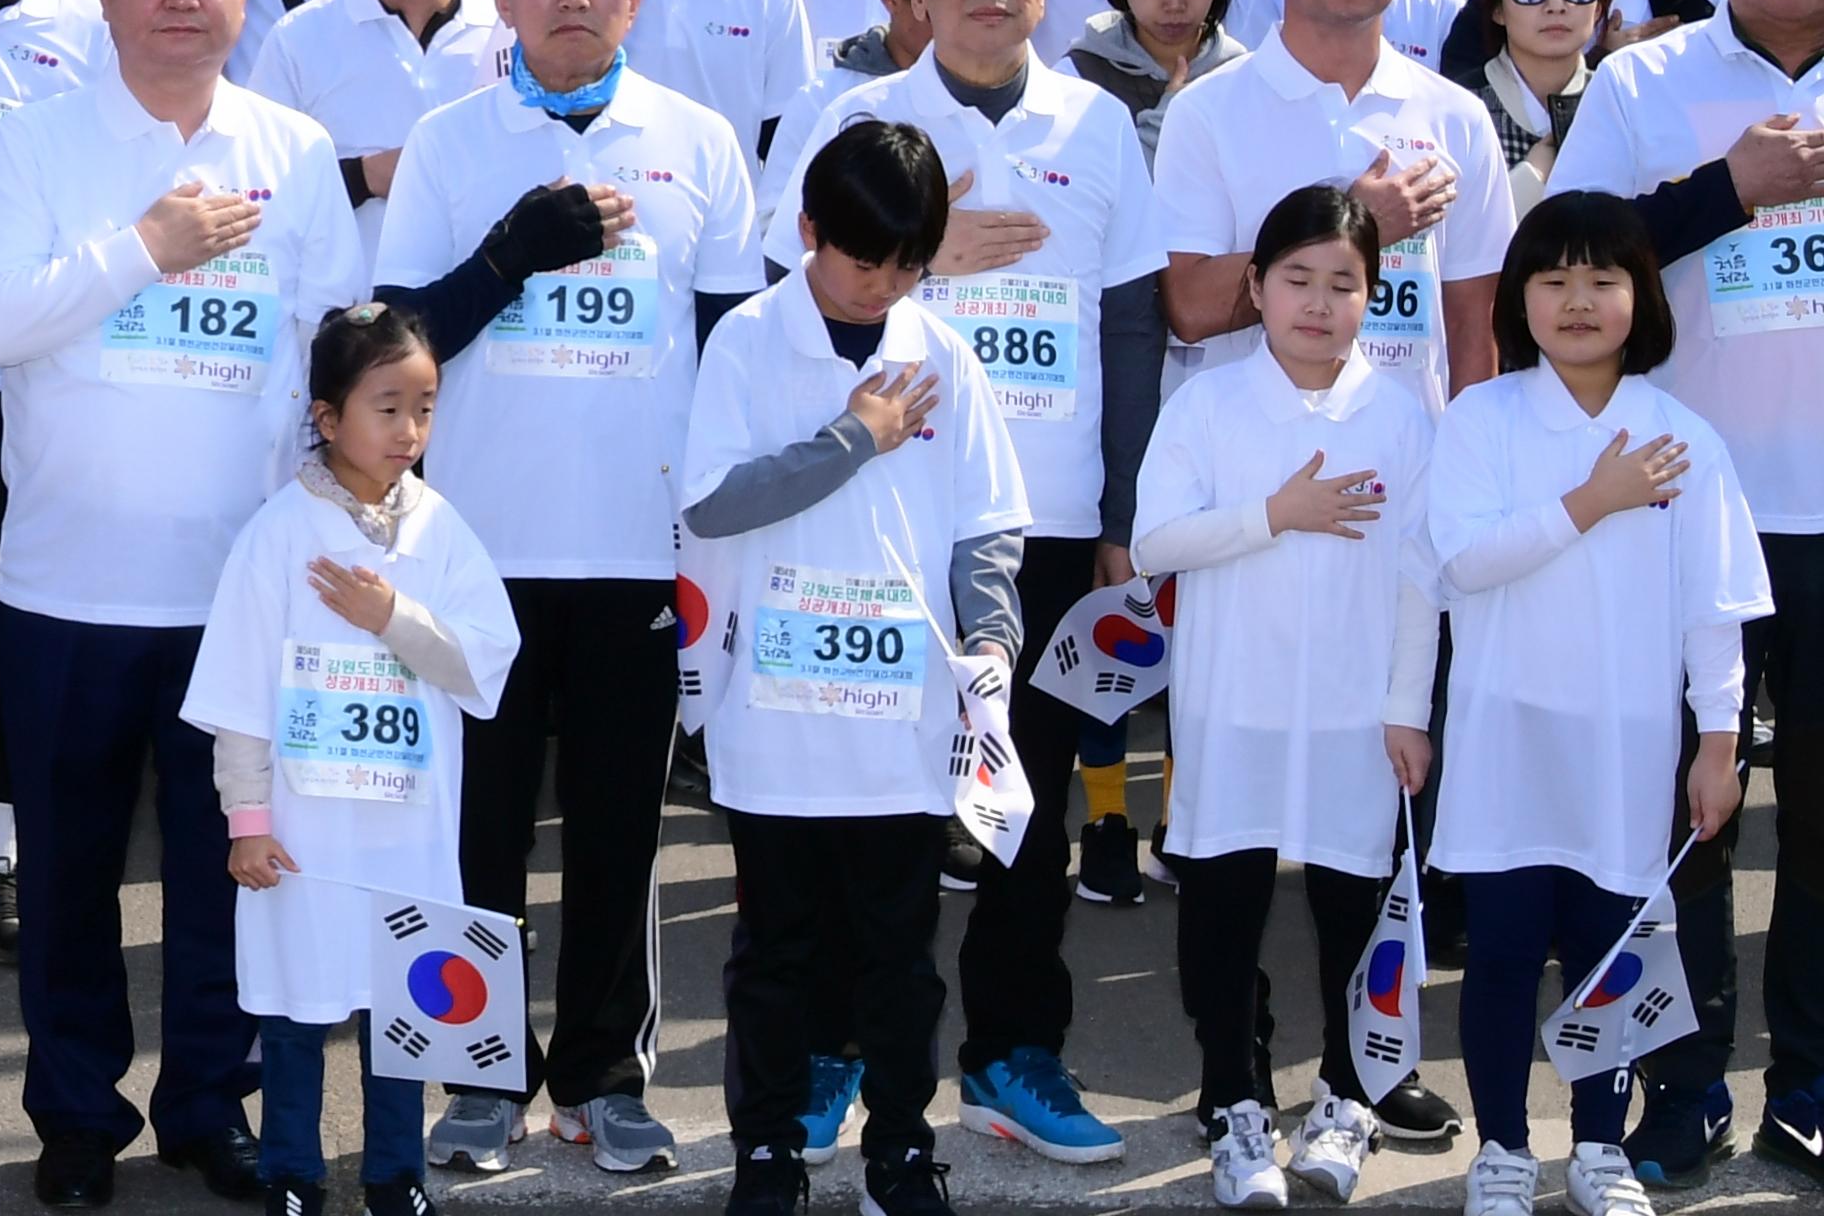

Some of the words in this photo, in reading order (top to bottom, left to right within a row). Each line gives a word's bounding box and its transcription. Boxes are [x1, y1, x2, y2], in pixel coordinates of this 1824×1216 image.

[587, 262, 612, 276] 기원
[211, 273, 238, 288] 기원
[547, 285, 635, 325] 199
[922, 287, 949, 301] 홍천
[955, 286, 1068, 305] 강원도민체육대회
[170, 295, 258, 340] 182
[954, 301, 1007, 316] 성공개최
[1013, 302, 1037, 318] 기원
[973, 326, 1058, 367] 886
[1005, 390, 1053, 411] high1
[770, 576, 795, 594] 홍천
[801, 581, 913, 602] 강원도민체육대회
[798, 597, 851, 616] 성공개최
[857, 603, 883, 617] 기원
[813, 624, 904, 665] 390
[295, 656, 320, 672] 홍천
[325, 675, 380, 692] 성공개최
[843, 688, 898, 709] high1
[340, 702, 420, 747] 389
